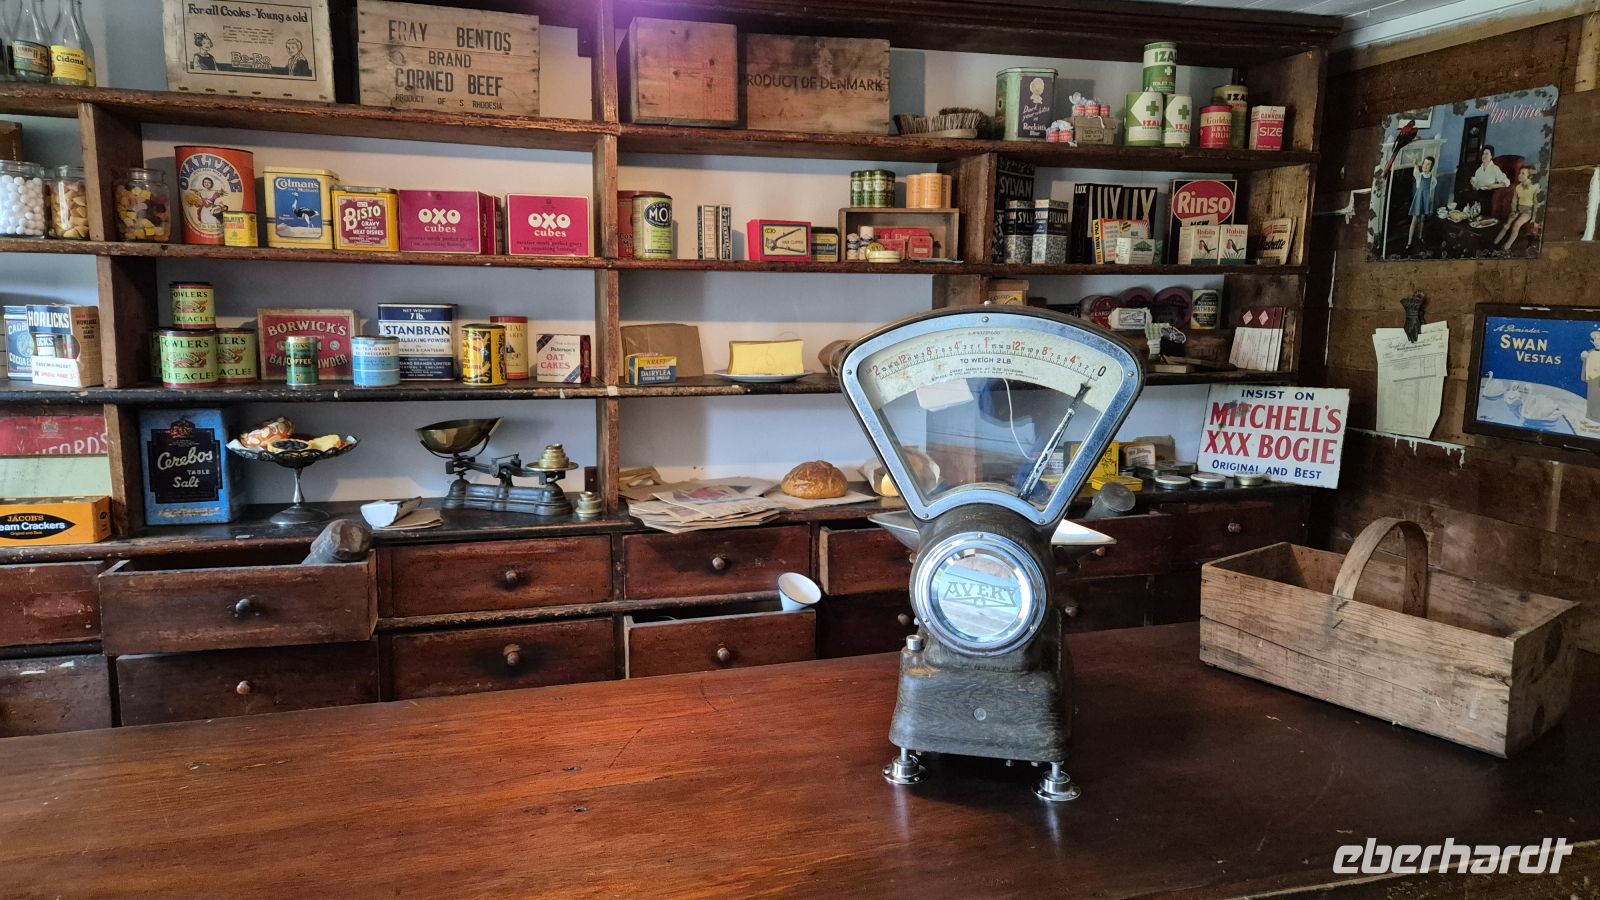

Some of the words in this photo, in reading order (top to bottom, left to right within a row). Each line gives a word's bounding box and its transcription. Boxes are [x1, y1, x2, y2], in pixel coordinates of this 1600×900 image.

[206, 6, 218, 15] all
[220, 6, 250, 18] Cooks
[256, 8, 284, 23] Young
[294, 12, 308, 22] old
[456, 26, 512, 51] BENTOS
[56, 54, 84, 65] Cidona
[428, 50, 472, 68] BRAND
[395, 68, 454, 92] CORNED
[467, 74, 504, 96] BEEF
[801, 76, 817, 89] OF
[820, 78, 884, 92] DENMARK
[396, 94, 424, 104] PRODUCT
[180, 154, 243, 192] OVALTINE
[275, 178, 319, 190] Colman's
[1000, 175, 1032, 198] SYLVAN
[1075, 185, 1087, 194] LUX
[1178, 190, 1231, 214] Rinso
[343, 205, 381, 231] BISTO
[418, 208, 461, 225] OXO
[528, 213, 571, 229] OXO
[1049, 212, 1068, 224] SYLVAN
[424, 224, 456, 233] cubes
[534, 228, 566, 237] cubes
[28, 311, 70, 328] HORLICKS
[268, 321, 347, 336] BORWICK'S
[385, 326, 450, 335] STANBRAN
[217, 336, 246, 345] LER'S
[1500, 334, 1548, 351] SWAN
[1012, 341, 1020, 351] 12
[1042, 347, 1048, 355] 8
[287, 357, 313, 365] COFFEE
[1516, 351, 1561, 365] VESTAS
[872, 365, 880, 376] 2
[1097, 366, 1106, 377] 0
[1241, 389, 1285, 399] INSIST
[1295, 392, 1315, 400] ON
[1210, 402, 1342, 434] MITCHELL'S
[1204, 430, 1252, 457] XXX
[1257, 434, 1338, 464] BOGIE
[157, 446, 213, 470] Cerebos
[1265, 467, 1288, 476] AND
[1294, 468, 1322, 480] BEST
[173, 476, 200, 488] Salt
[21, 522, 65, 530] Crackers
[944, 582, 1016, 607] AVERY
